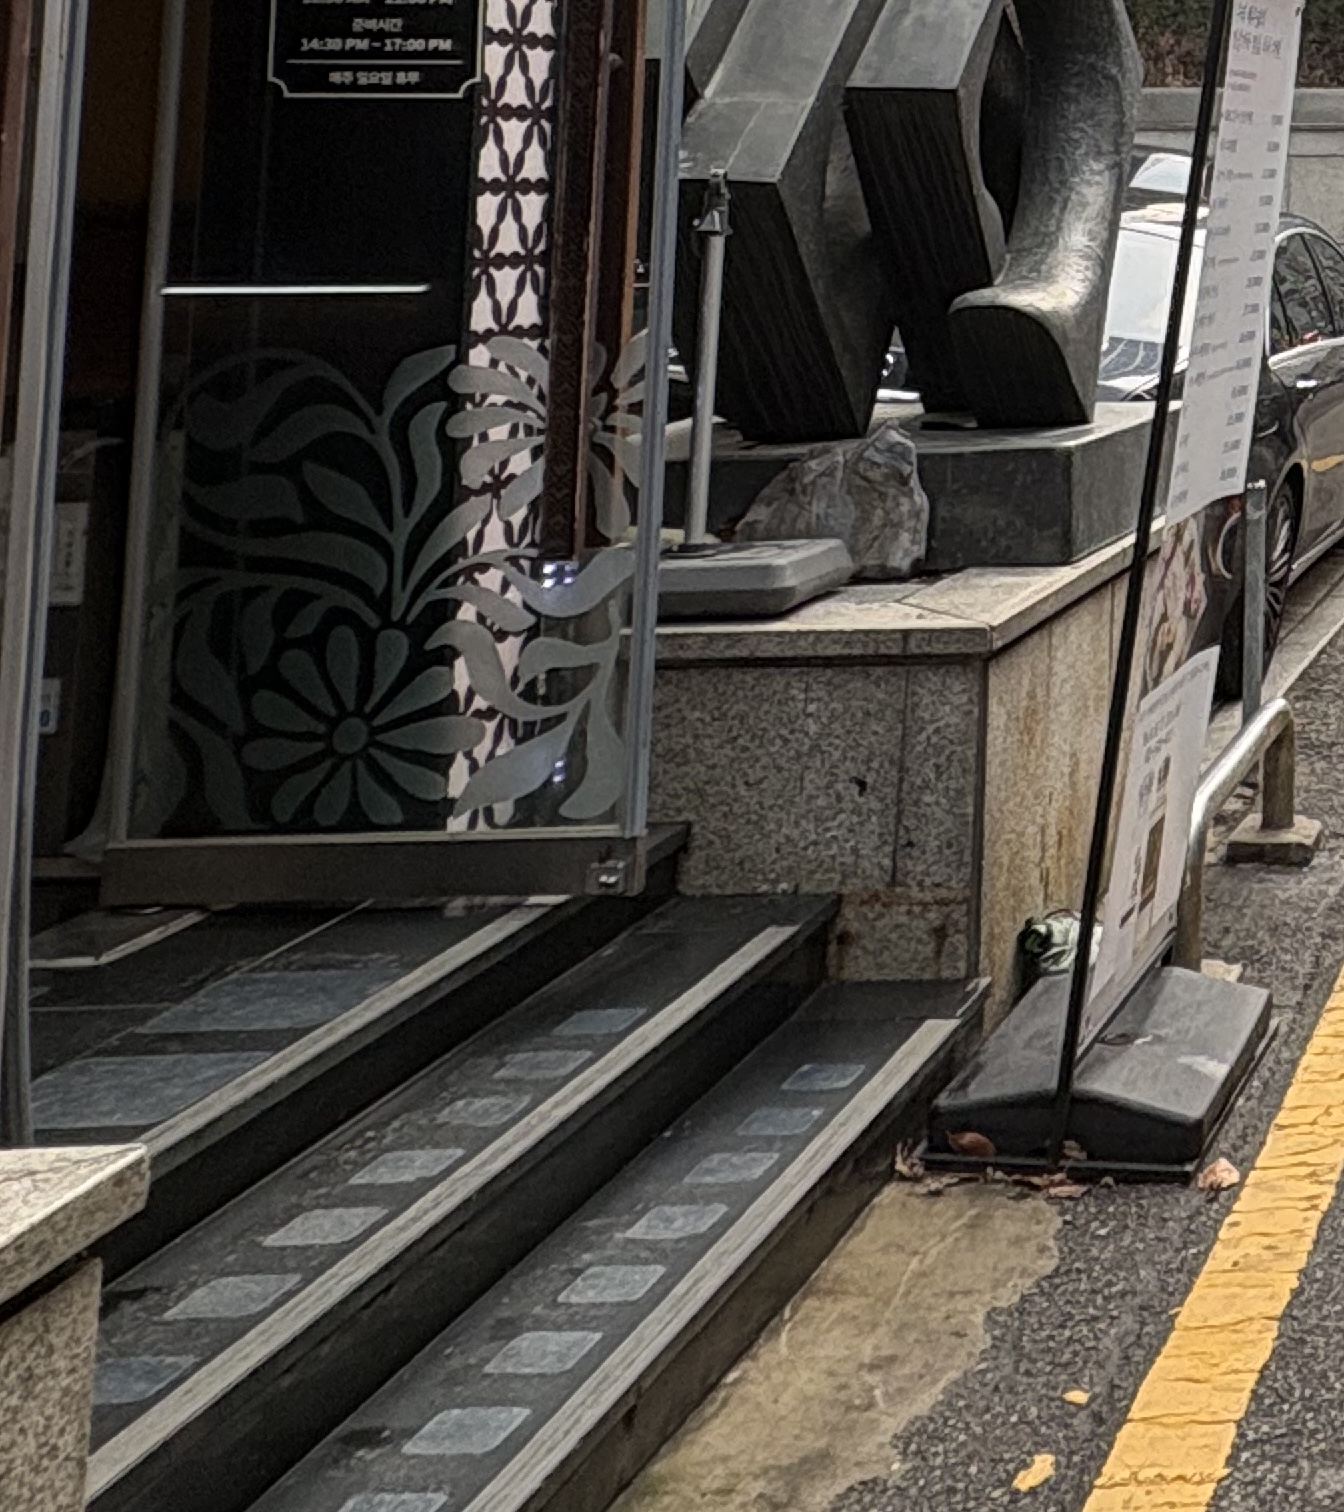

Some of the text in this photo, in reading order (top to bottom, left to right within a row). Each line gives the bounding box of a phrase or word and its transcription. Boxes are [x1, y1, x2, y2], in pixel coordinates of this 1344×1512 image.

[300, 38, 342, 52] 14:30
[344, 38, 369, 51] PM
[384, 38, 426, 51] 17:00
[428, 38, 452, 51] PM
